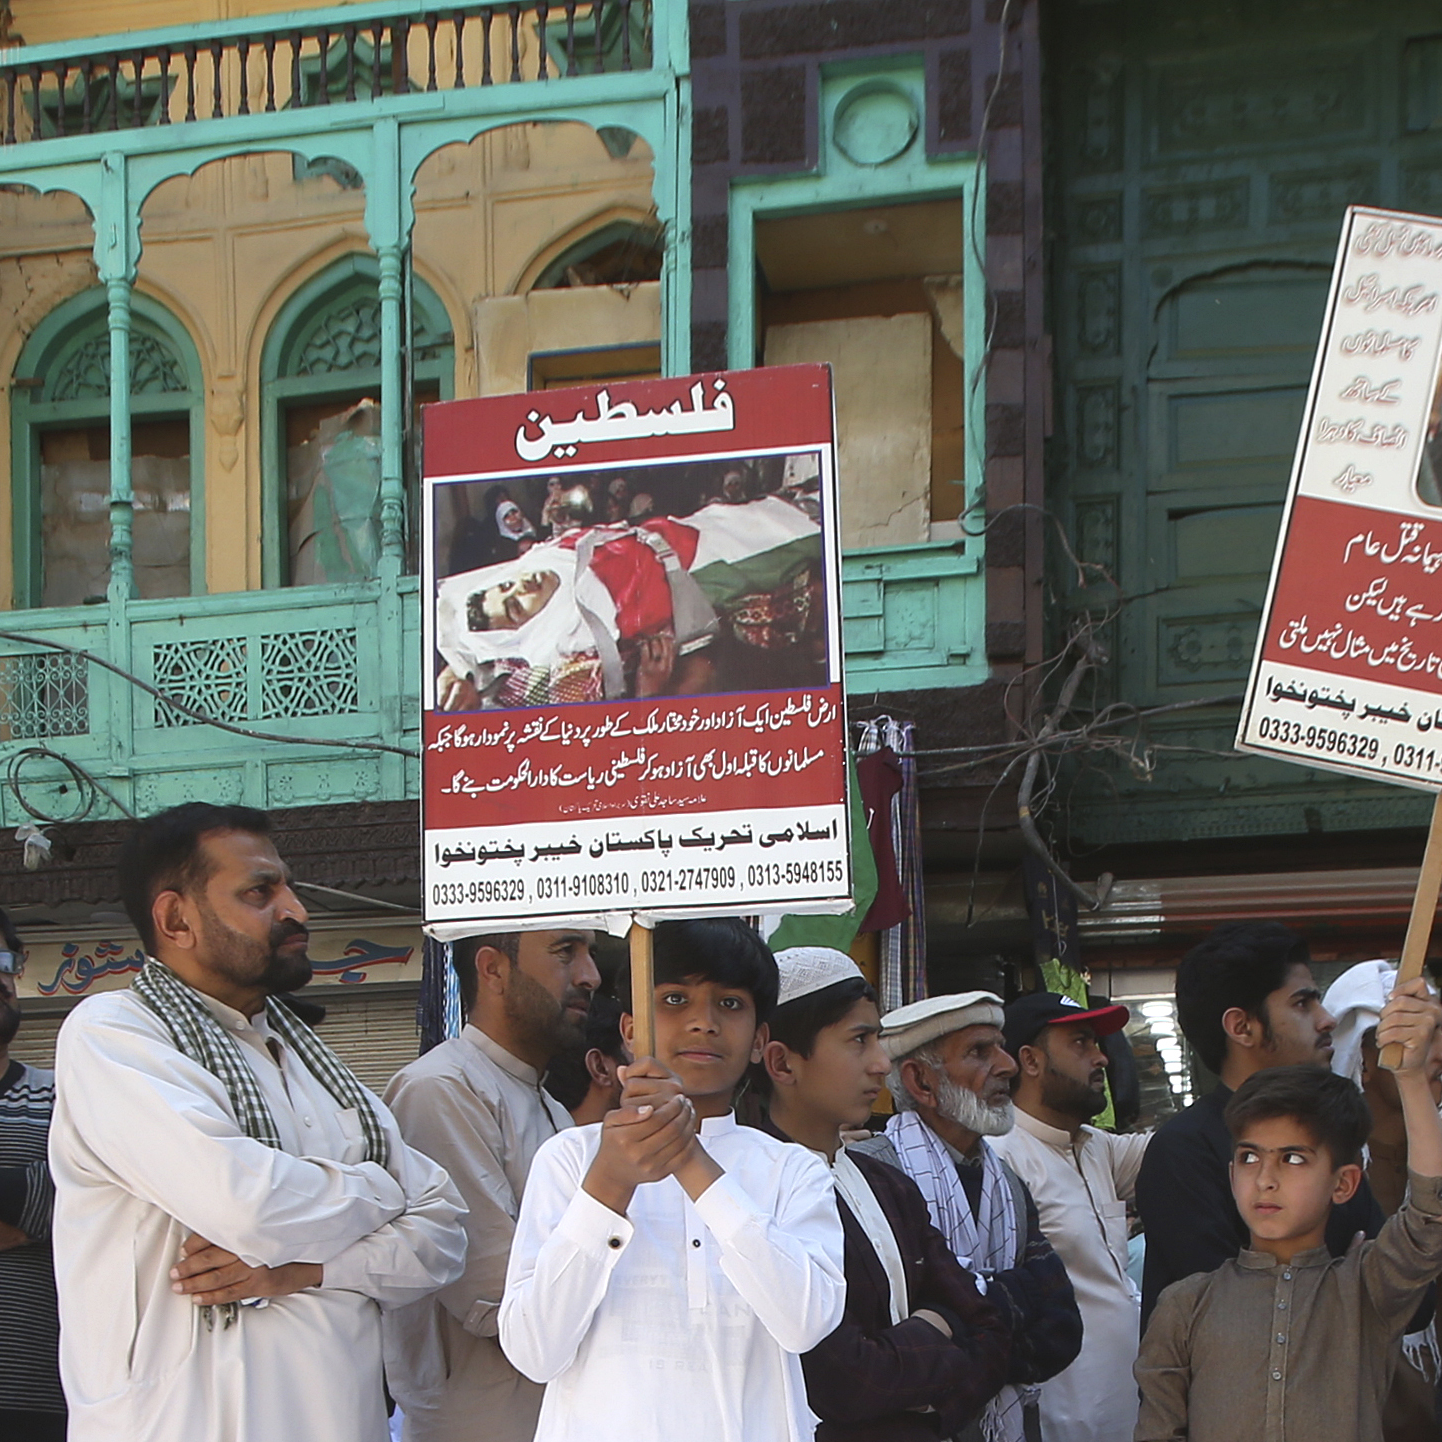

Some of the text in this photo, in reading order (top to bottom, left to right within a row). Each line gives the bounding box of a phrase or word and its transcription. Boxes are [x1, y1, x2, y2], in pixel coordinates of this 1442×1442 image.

[515, 378, 736, 461] فلسطین
[1343, 530, 1380, 564] عام
[1380, 522, 1425, 563] قتل
[1345, 576, 1389, 612] لیکن
[1376, 595, 1407, 621] ہیں
[1279, 615, 1309, 649] ملتی
[1300, 622, 1343, 653] نہیں
[1329, 629, 1370, 659] مثال
[1367, 641, 1400, 666] میں
[1396, 637, 1441, 672] تاریخ
[769, 694, 812, 730] فلسطین
[808, 697, 837, 728] ارض
[1265, 675, 1356, 720] پختونخوا
[1357, 700, 1412, 725] خیبر
[516, 716, 544, 744] نقشہ
[539, 716, 561, 741] کے
[591, 715, 614, 739] طور
[610, 711, 630, 737] کے
[632, 707, 659, 735] ملک
[697, 713, 716, 731] اور
[715, 705, 746, 729] آزاد
[741, 703, 770, 733] ایک
[427, 724, 453, 752] جبکہ
[475, 721, 511, 747] نمودار
[503, 731, 516, 752] پر
[560, 721, 581, 746] دنیا
[580, 725, 592, 747] پر
[1259, 716, 1380, 760] 0333-9596329
[461, 747, 824, 798] مسلمانوں کا قبلہ اول بھی آزاد فلسطینی ریاست کا دارالحکومت بنے
[434, 818, 838, 867] اسلامی تحریک پاکستان خیبر پختونخوا
[433, 859, 843, 906] 0333-9596329 0311-9108310 0321-2747909 0313-5948155
